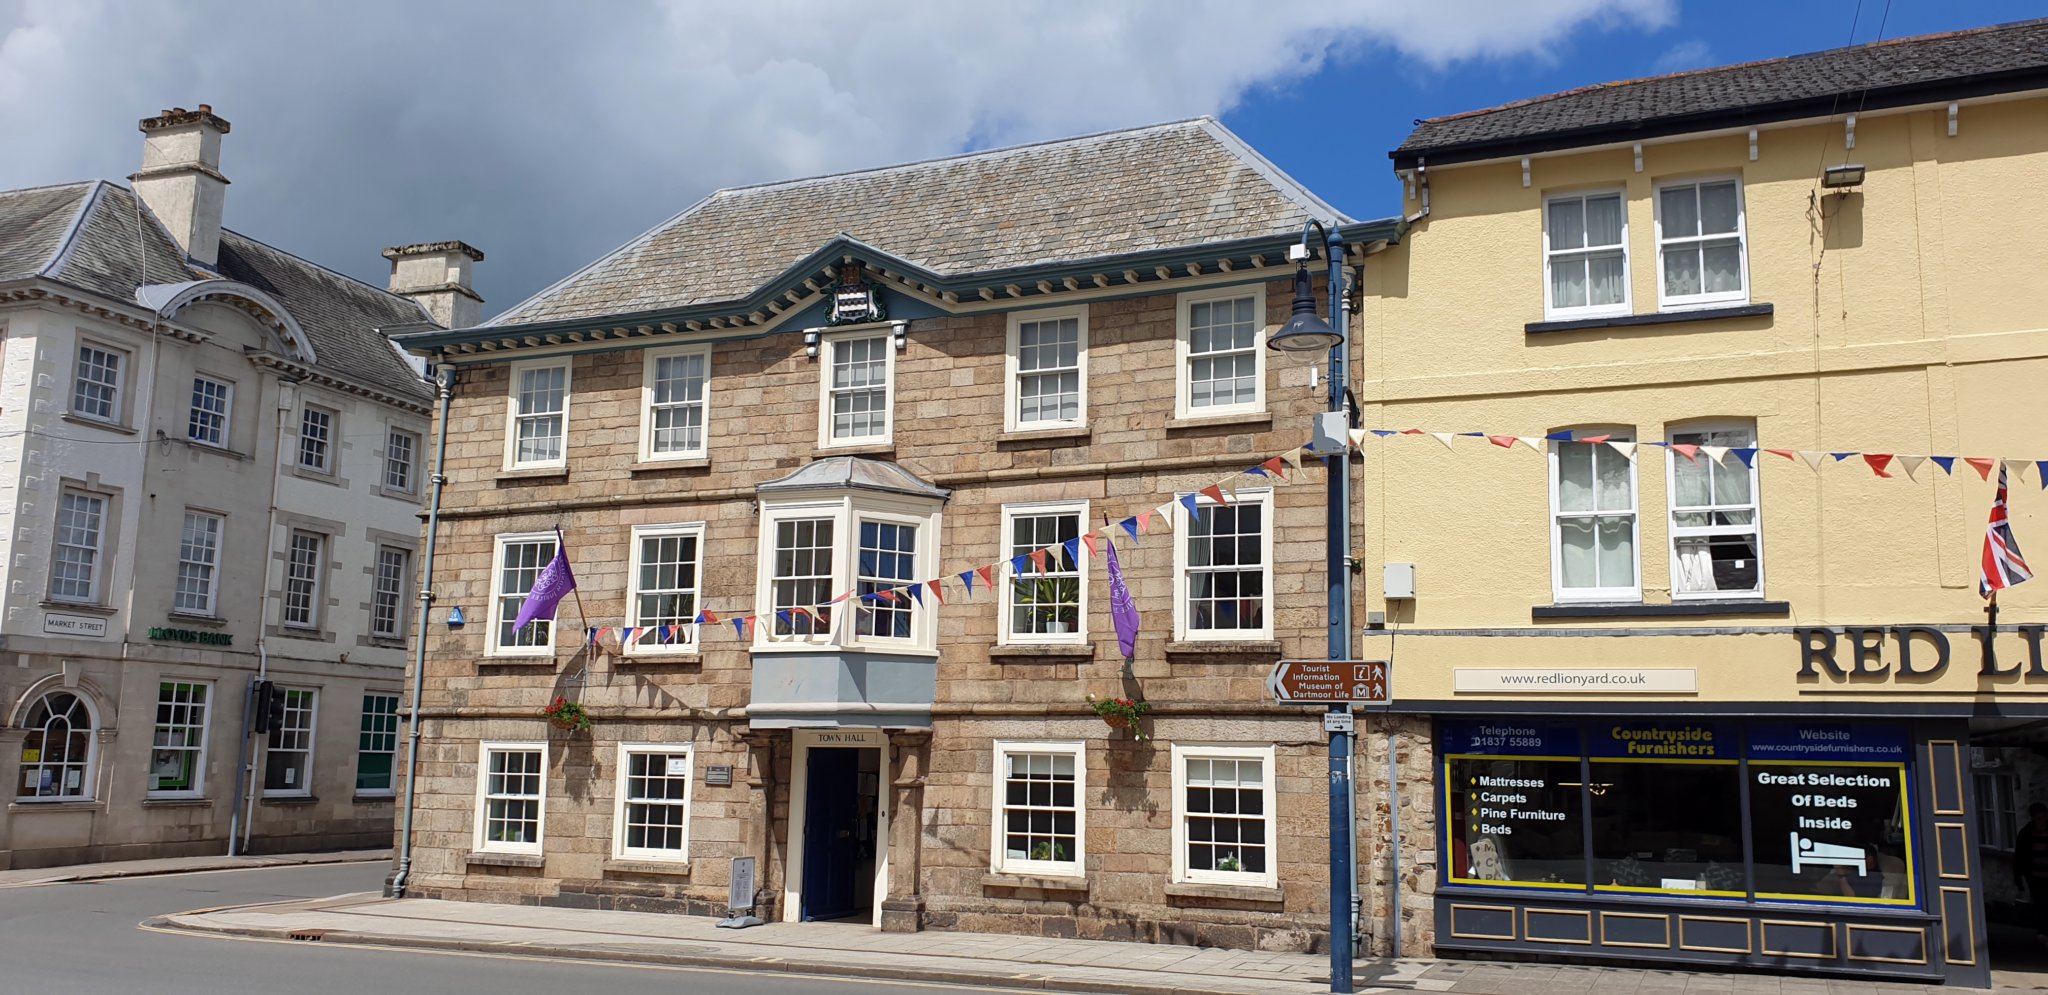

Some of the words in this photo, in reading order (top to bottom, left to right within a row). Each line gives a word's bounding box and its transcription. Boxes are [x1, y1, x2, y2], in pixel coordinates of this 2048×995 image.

[48, 619, 76, 629] MARKET
[79, 622, 104, 632] STREET
[148, 626, 198, 643] LLOYDS
[199, 631, 233, 646] BANK
[1793, 626, 1950, 677] RED
[1302, 664, 1330, 672] Tourist
[1293, 673, 1340, 681] Information
[1500, 673, 1646, 687] www.redlionyard.co.uk
[1299, 682, 1332, 690] Museum
[1334, 682, 1344, 690] of
[1334, 691, 1349, 699] Life
[1480, 725, 1536, 737] Telephone
[1611, 726, 1713, 744] Countryside
[1799, 729, 1850, 740] Website
[818, 734, 841, 742] TOWN
[1475, 736, 1506, 747] 01837
[1509, 737, 1542, 747] 55889
[1752, 743, 1903, 754] www.countrysidefurnishers.co.uk
[1480, 776, 1545, 788] Mattresses
[1757, 772, 1806, 785] Great
[1808, 773, 1891, 787] Selection
[1481, 792, 1527, 805] Carpets
[1791, 794, 1811, 807] Of
[1813, 795, 1858, 808] Beds
[1481, 807, 1507, 818] Pine
[1510, 808, 1566, 820] Furniture
[1799, 816, 1852, 829] Inside
[1481, 823, 1512, 835] Beds
